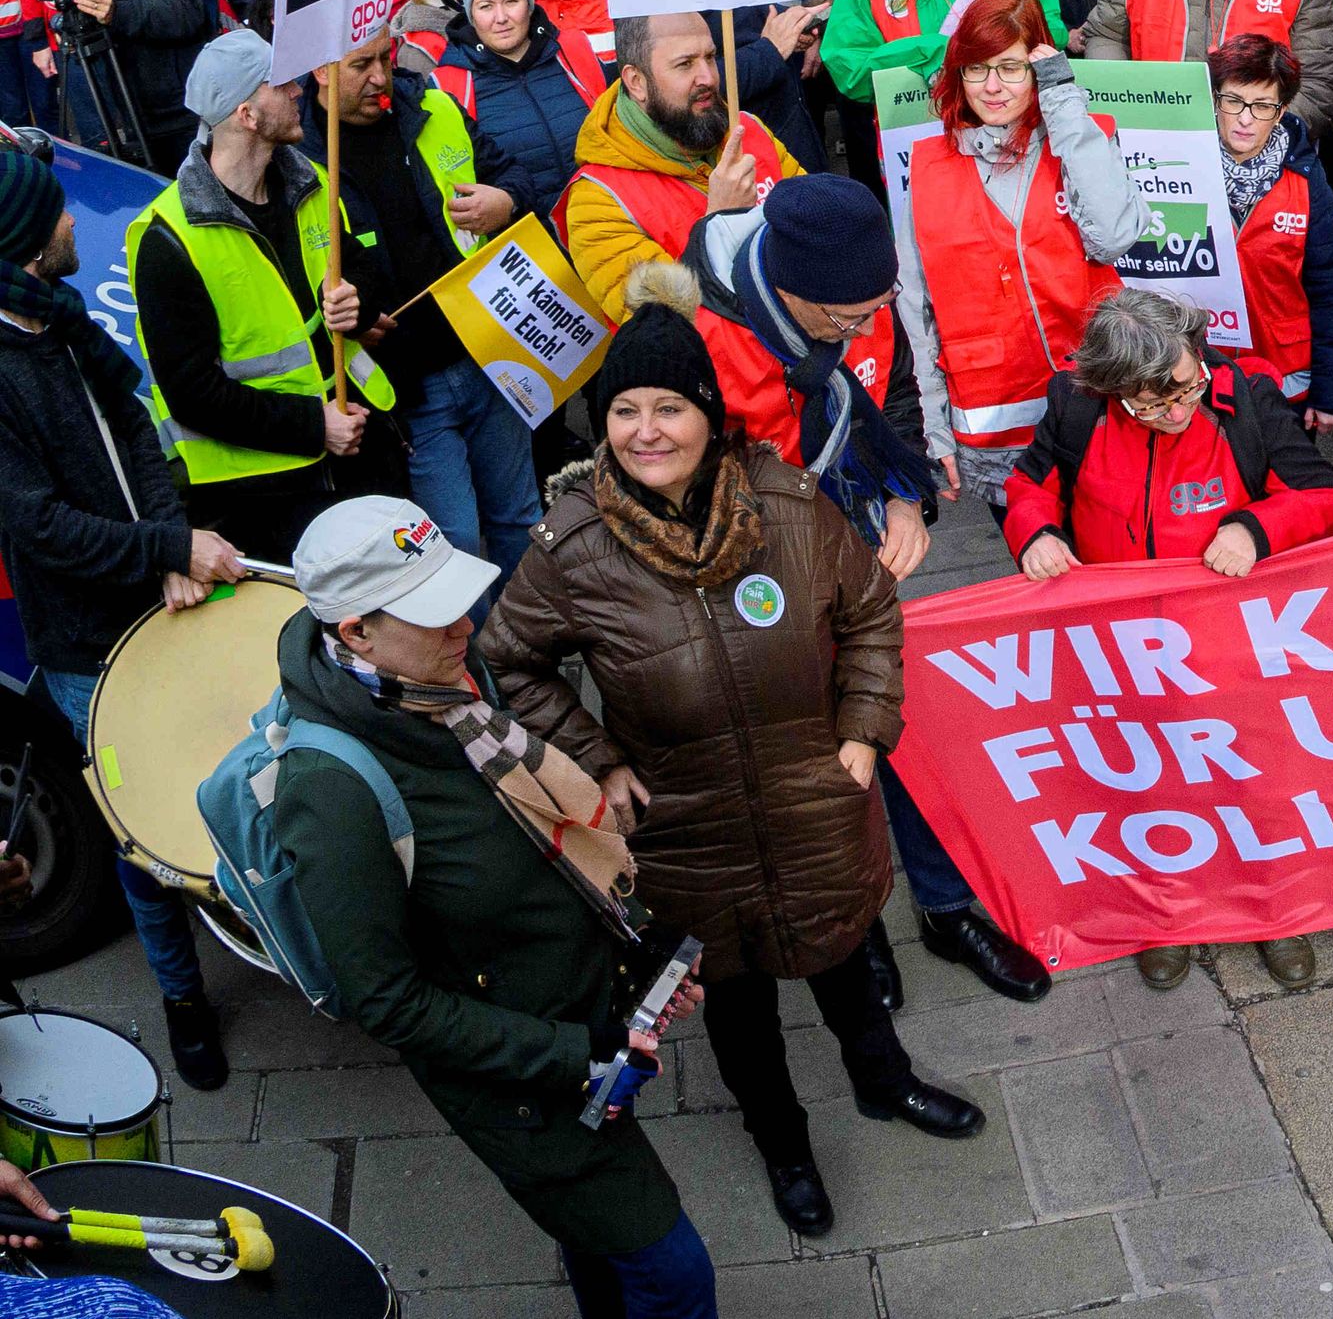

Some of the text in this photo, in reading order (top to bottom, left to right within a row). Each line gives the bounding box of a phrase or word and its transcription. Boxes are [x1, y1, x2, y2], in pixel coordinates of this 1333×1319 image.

[1274, 212, 1307, 234] gpa
[499, 245, 594, 347] Wir kämpfen
[1146, 256, 1180, 273] sein
[488, 285, 565, 361] für Euch!
[1170, 477, 1226, 516] gpa
[925, 618, 1216, 710] WIR
[982, 701, 1264, 804] FÜR
